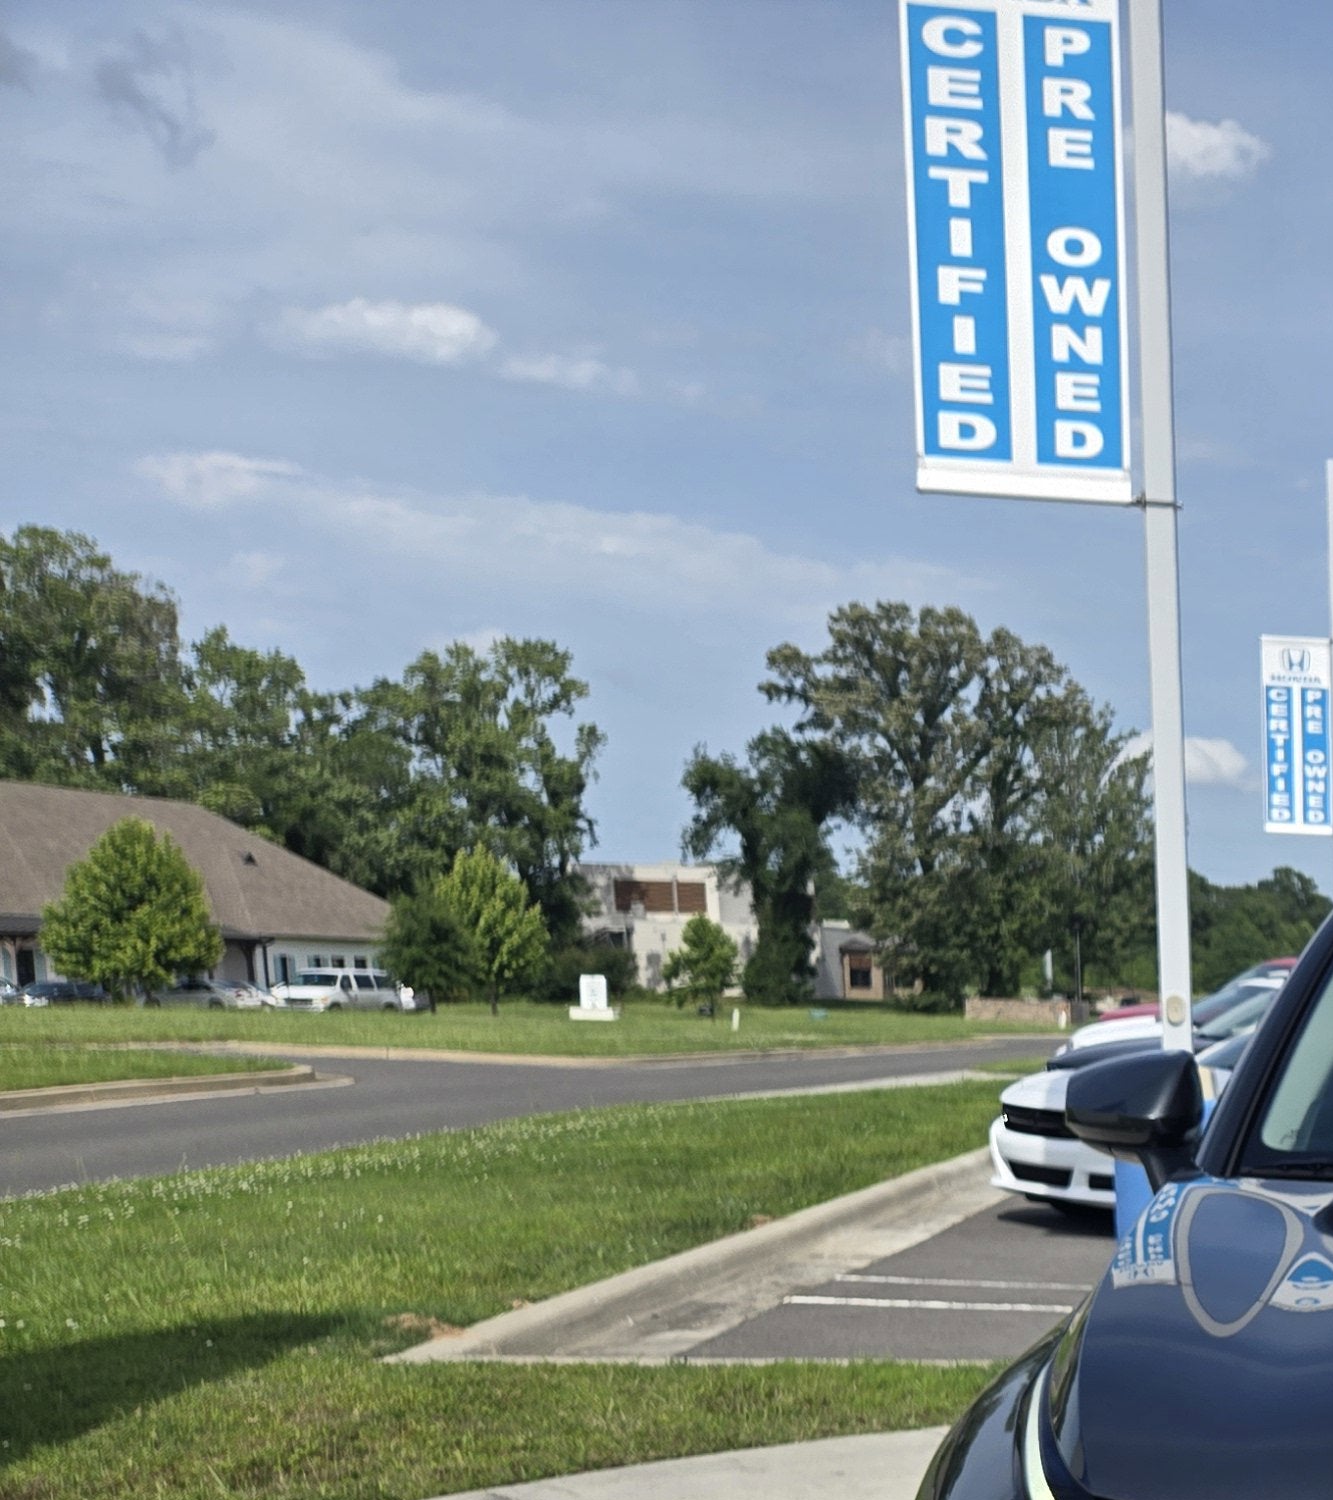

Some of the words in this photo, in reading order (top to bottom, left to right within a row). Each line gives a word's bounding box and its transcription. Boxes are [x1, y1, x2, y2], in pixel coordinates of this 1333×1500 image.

[1042, 25, 1096, 170] PRE
[921, 15, 998, 452] CERTIFIED
[1039, 226, 1112, 460] OWNED
[1268, 688, 1291, 822] CERTIFIED
[1305, 690, 1323, 735] PRE
[1304, 749, 1328, 823] OWNED
